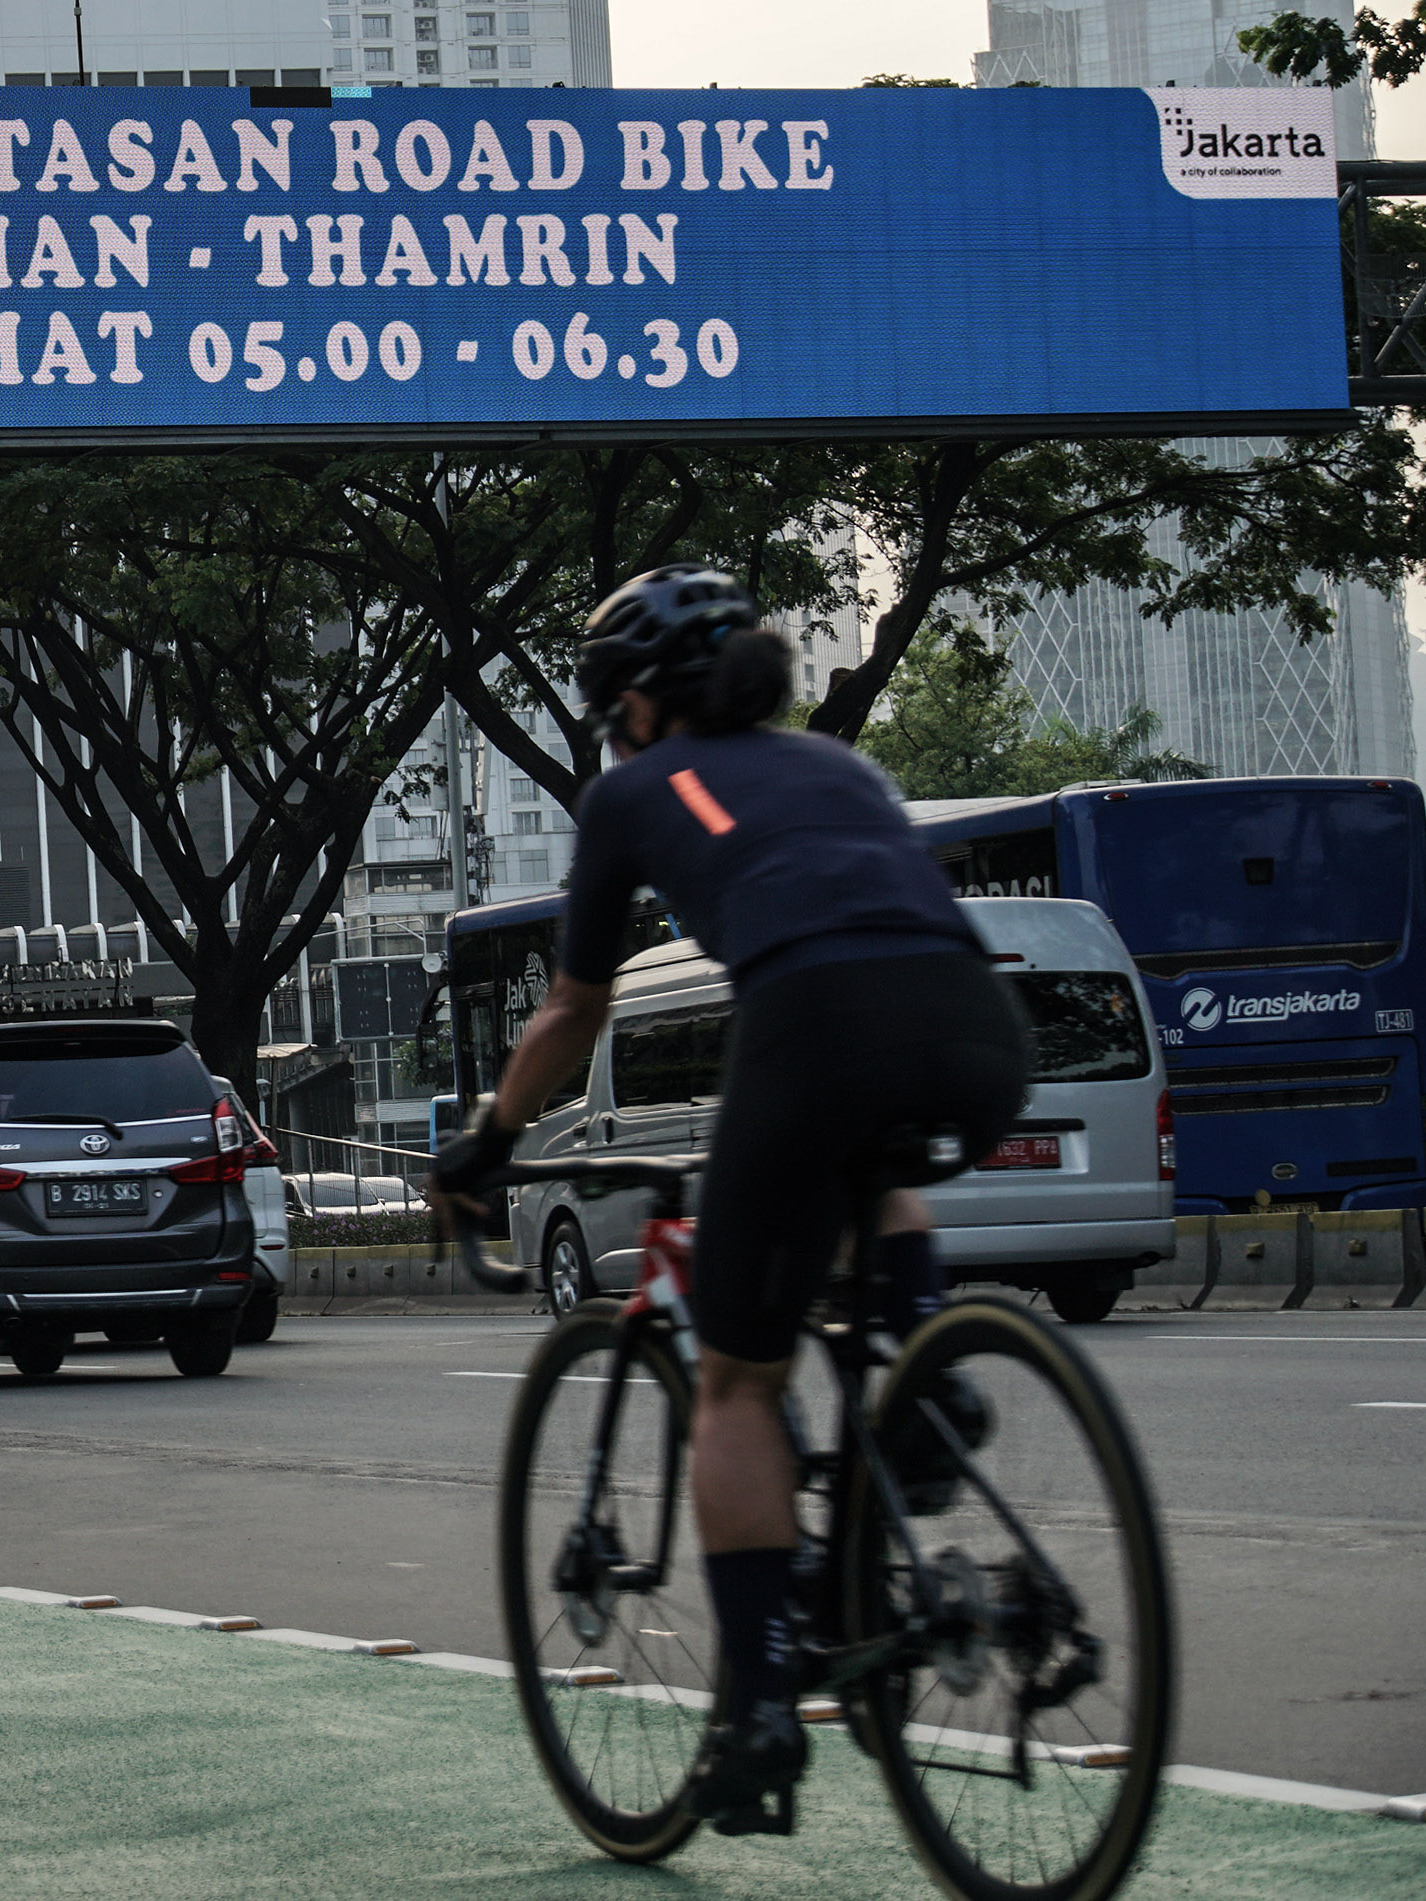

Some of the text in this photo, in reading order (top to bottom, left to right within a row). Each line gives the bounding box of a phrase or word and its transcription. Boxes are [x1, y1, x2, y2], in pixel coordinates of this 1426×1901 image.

[329, 119, 585, 193] ROAD
[618, 120, 834, 191] BIKE
[1188, 167, 1205, 178] city
[1207, 167, 1217, 176] of
[1219, 167, 1282, 176] collaboration
[244, 213, 678, 287] THAMRIN
[189, 320, 422, 392] 05.00
[512, 312, 739, 388] 06.30
[1, 984, 134, 1014] SENAYAN
[504, 977, 527, 1011] Jak
[1226, 989, 1361, 1022] transjakarta
[505, 1012, 532, 1049] Lin
[1377, 1012, 1411, 1030] TJ-481
[50, 1182, 142, 1202] B 2914 SKS
